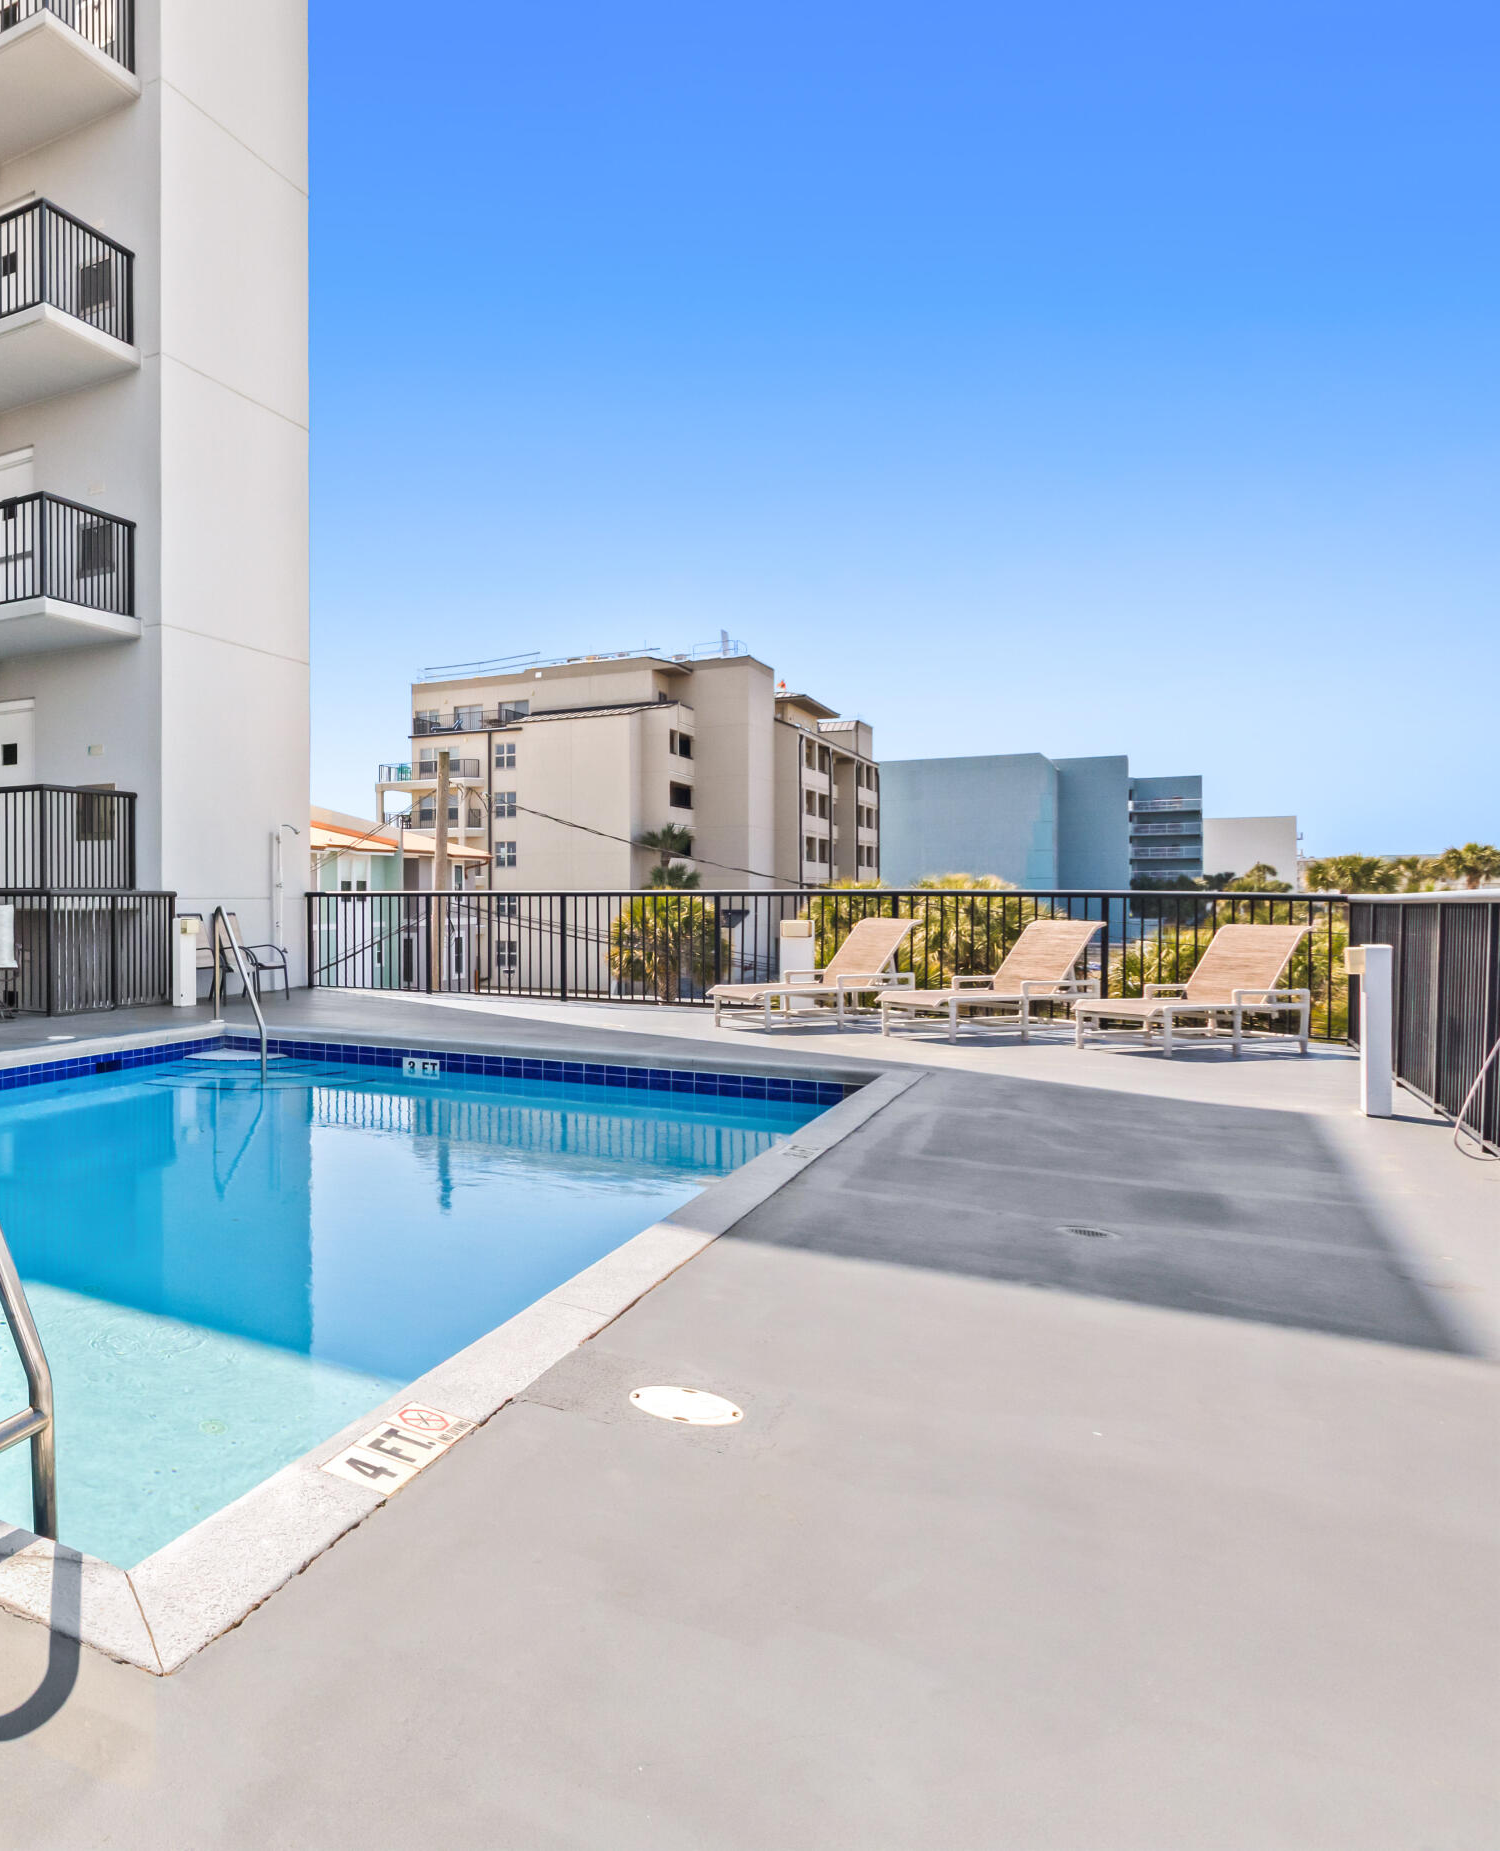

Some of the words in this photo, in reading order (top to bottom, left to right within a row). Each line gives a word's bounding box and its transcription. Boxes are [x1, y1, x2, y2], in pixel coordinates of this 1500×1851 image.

[422, 1062, 437, 1073] FT
[368, 1428, 437, 1463] FT.
[345, 1457, 398, 1480] 4
